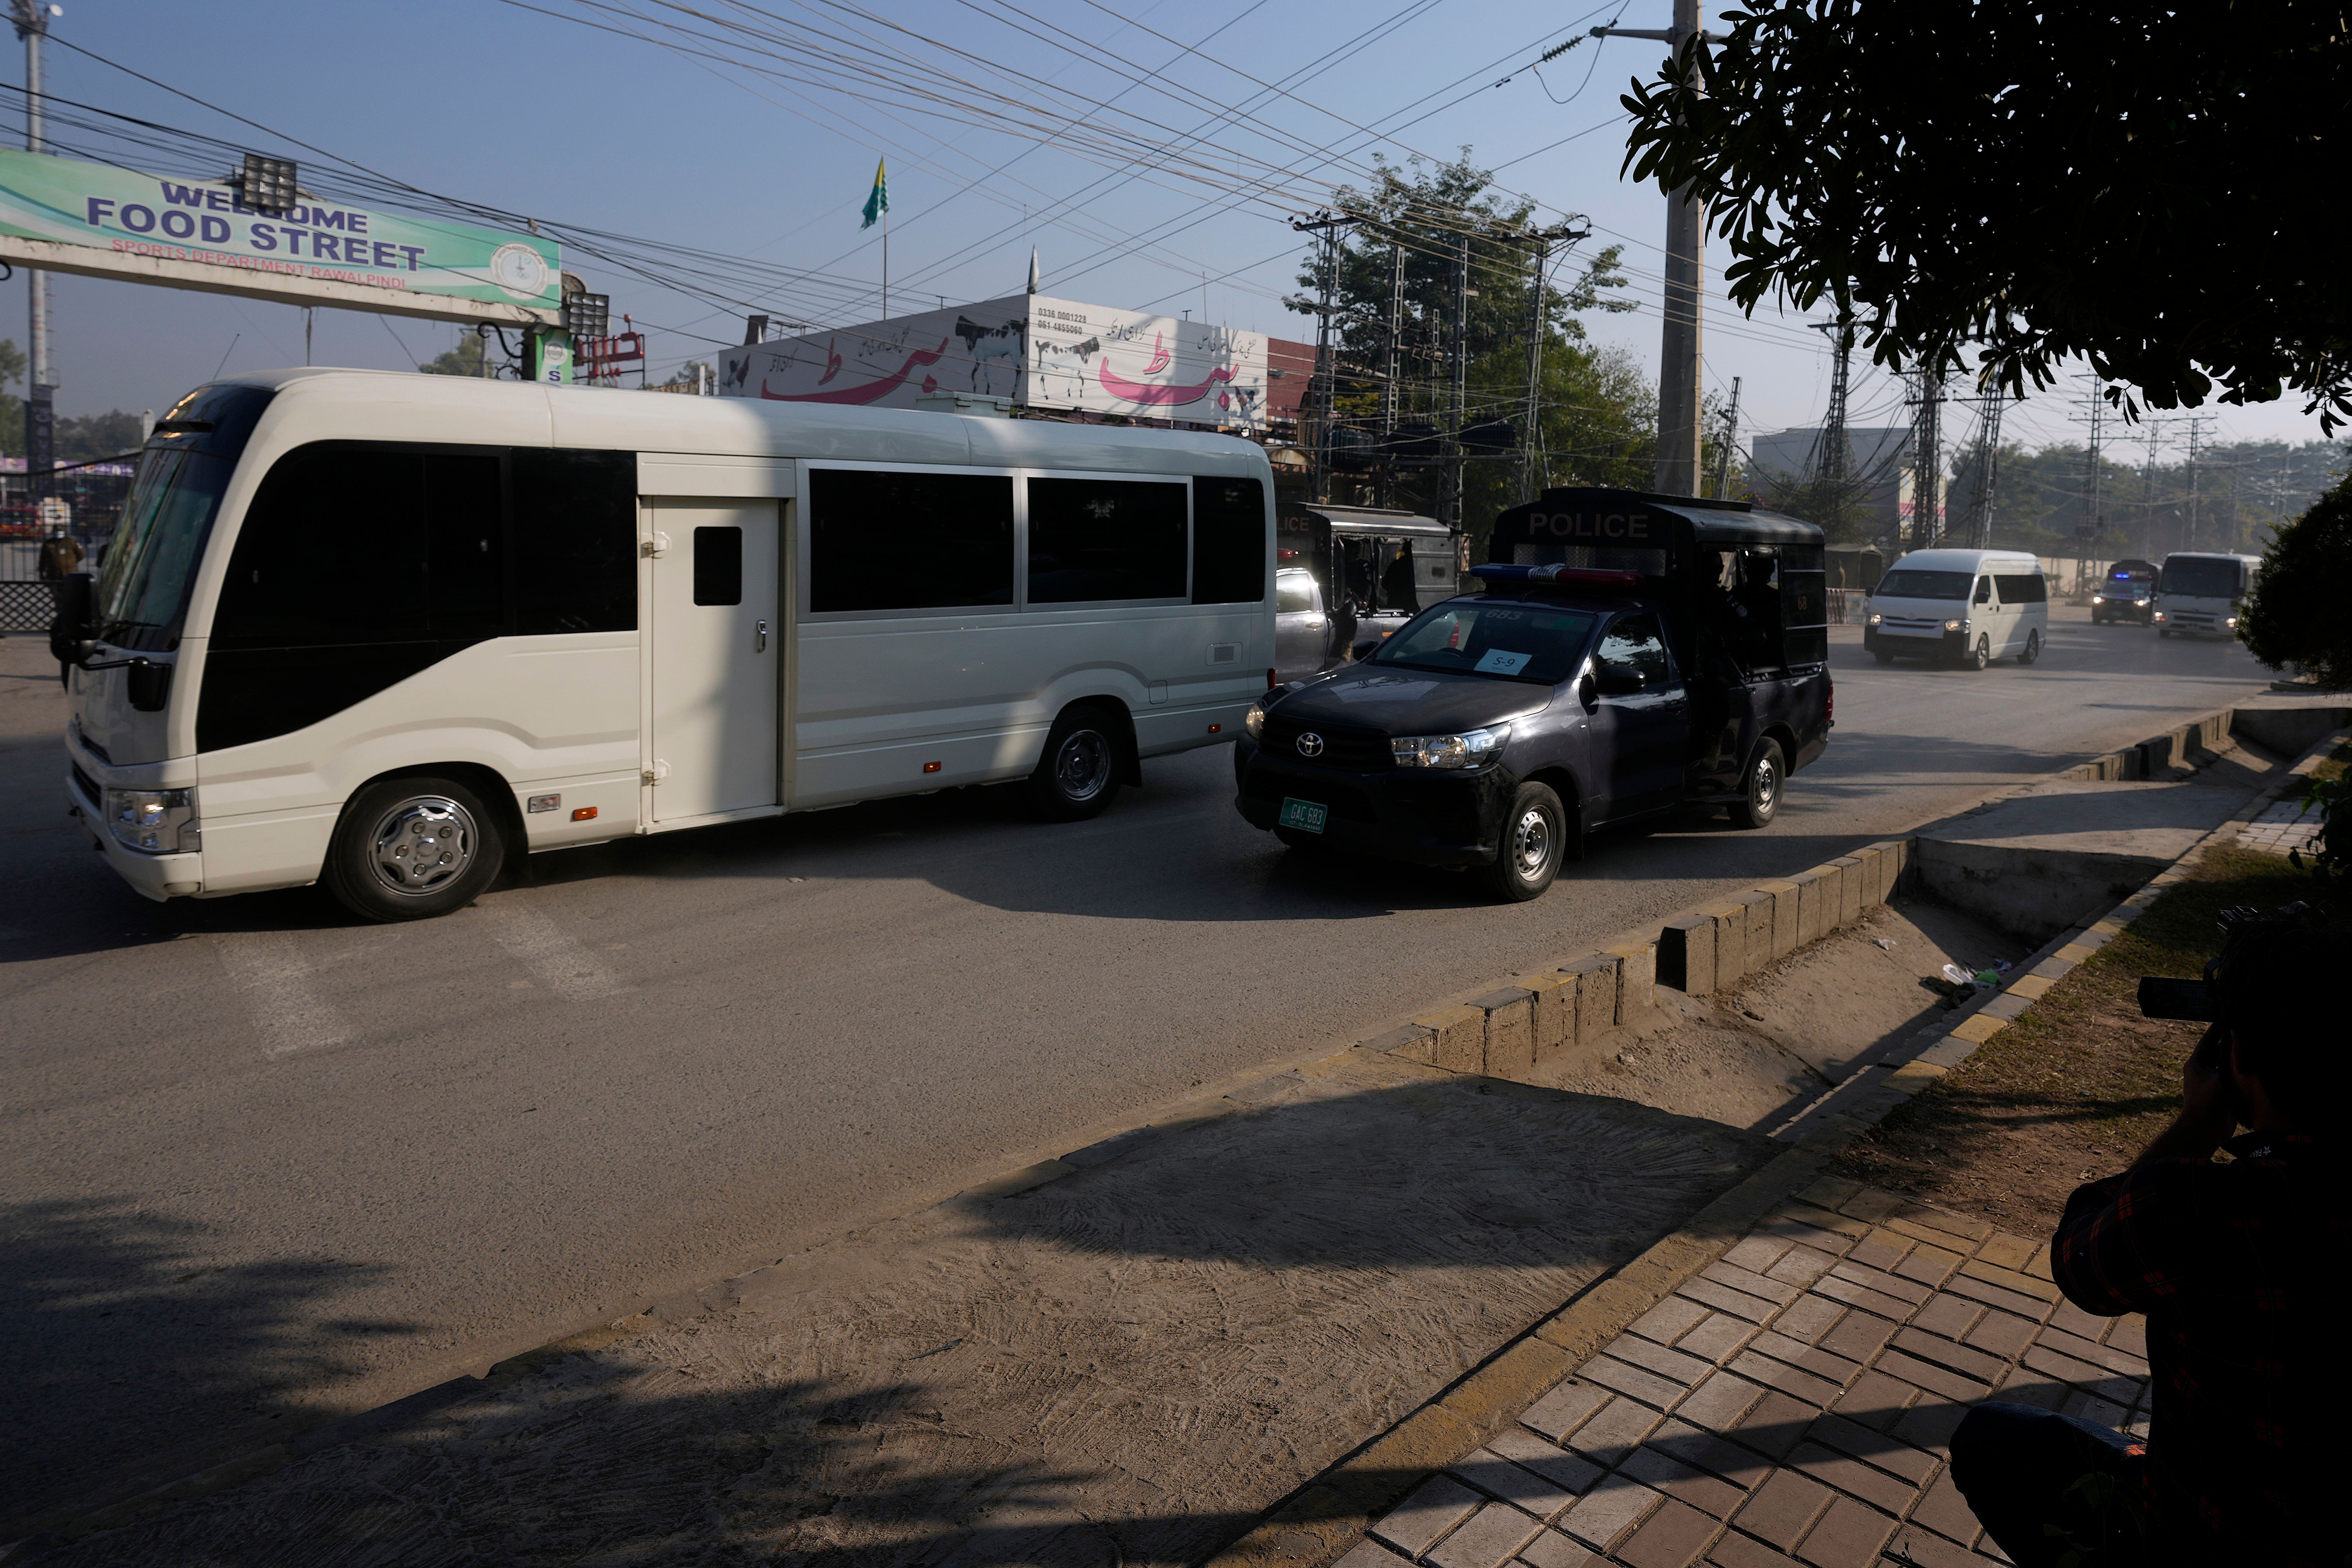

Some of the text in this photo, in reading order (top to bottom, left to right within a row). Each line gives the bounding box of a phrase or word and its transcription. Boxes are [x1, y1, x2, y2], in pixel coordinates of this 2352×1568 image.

[87, 197, 425, 271] FOOD STREET
[112, 238, 406, 289] SPORTS DEPARTMENT RAWALPINDI
[549, 370, 561, 381] S
[1529, 512, 1649, 538] POLICE
[1492, 657, 1515, 667] S-9
[1290, 804, 1323, 825] GAC 683
